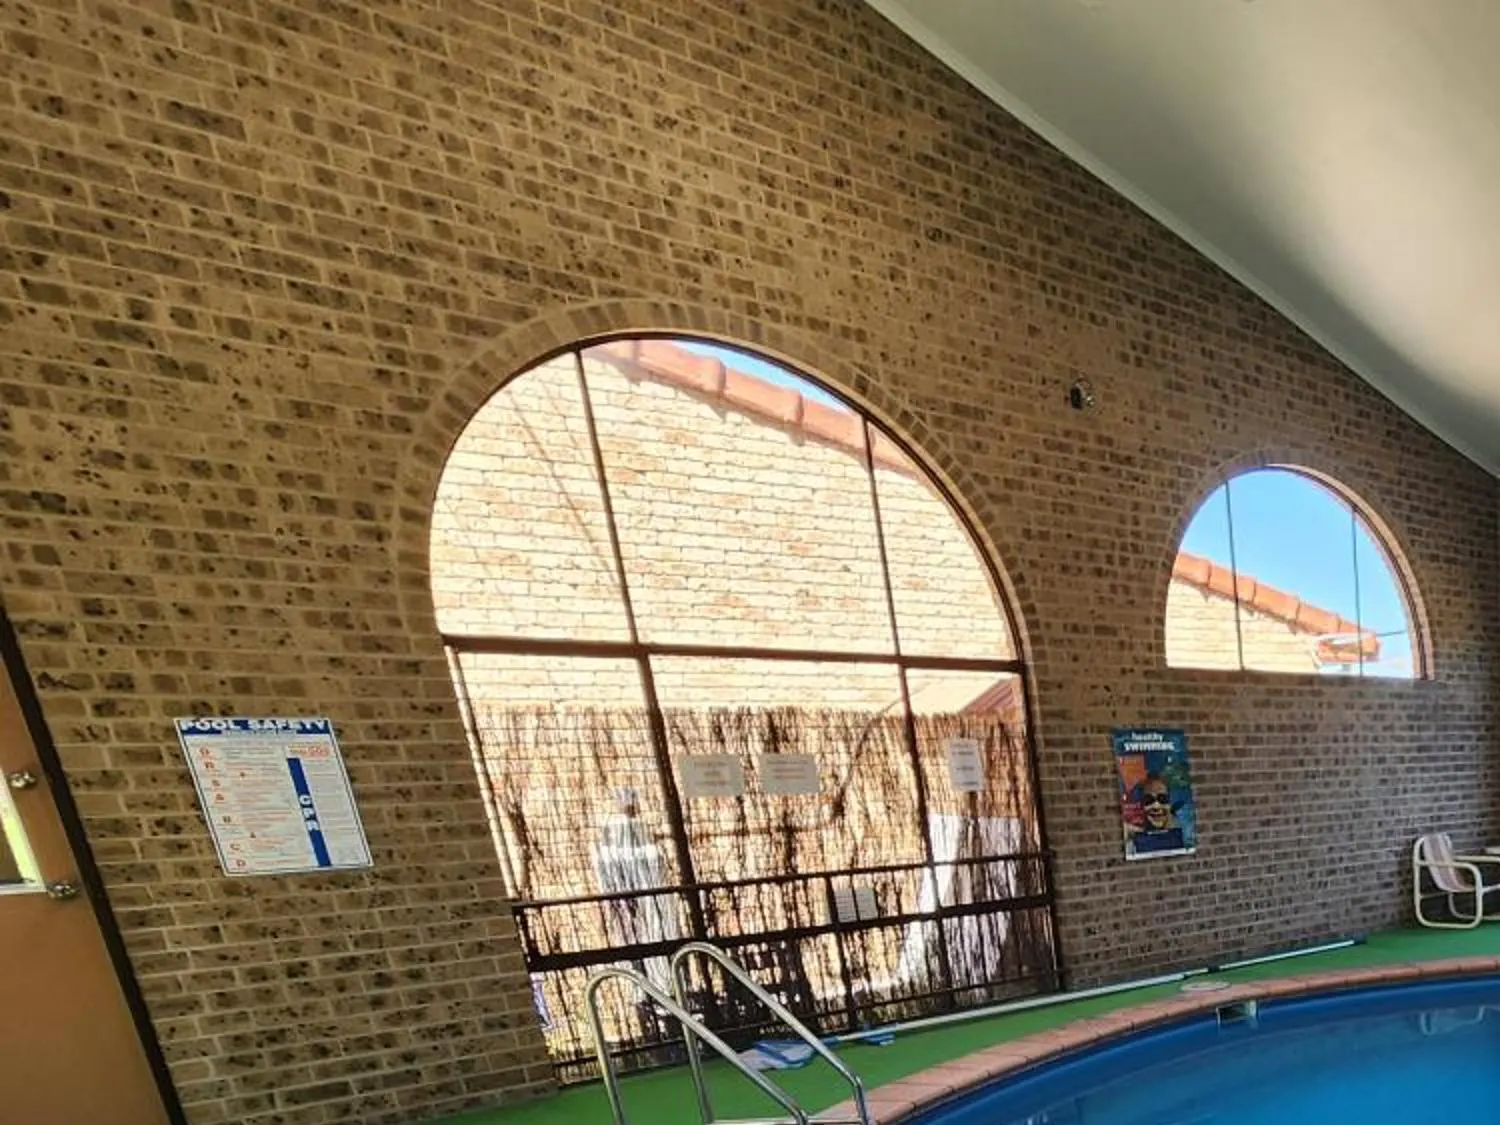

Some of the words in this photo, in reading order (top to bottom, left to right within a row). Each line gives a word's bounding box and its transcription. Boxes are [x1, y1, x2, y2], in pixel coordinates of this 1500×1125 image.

[181, 719, 239, 731] POOL
[246, 719, 326, 731] SAFETY
[299, 795, 320, 831] CPR
